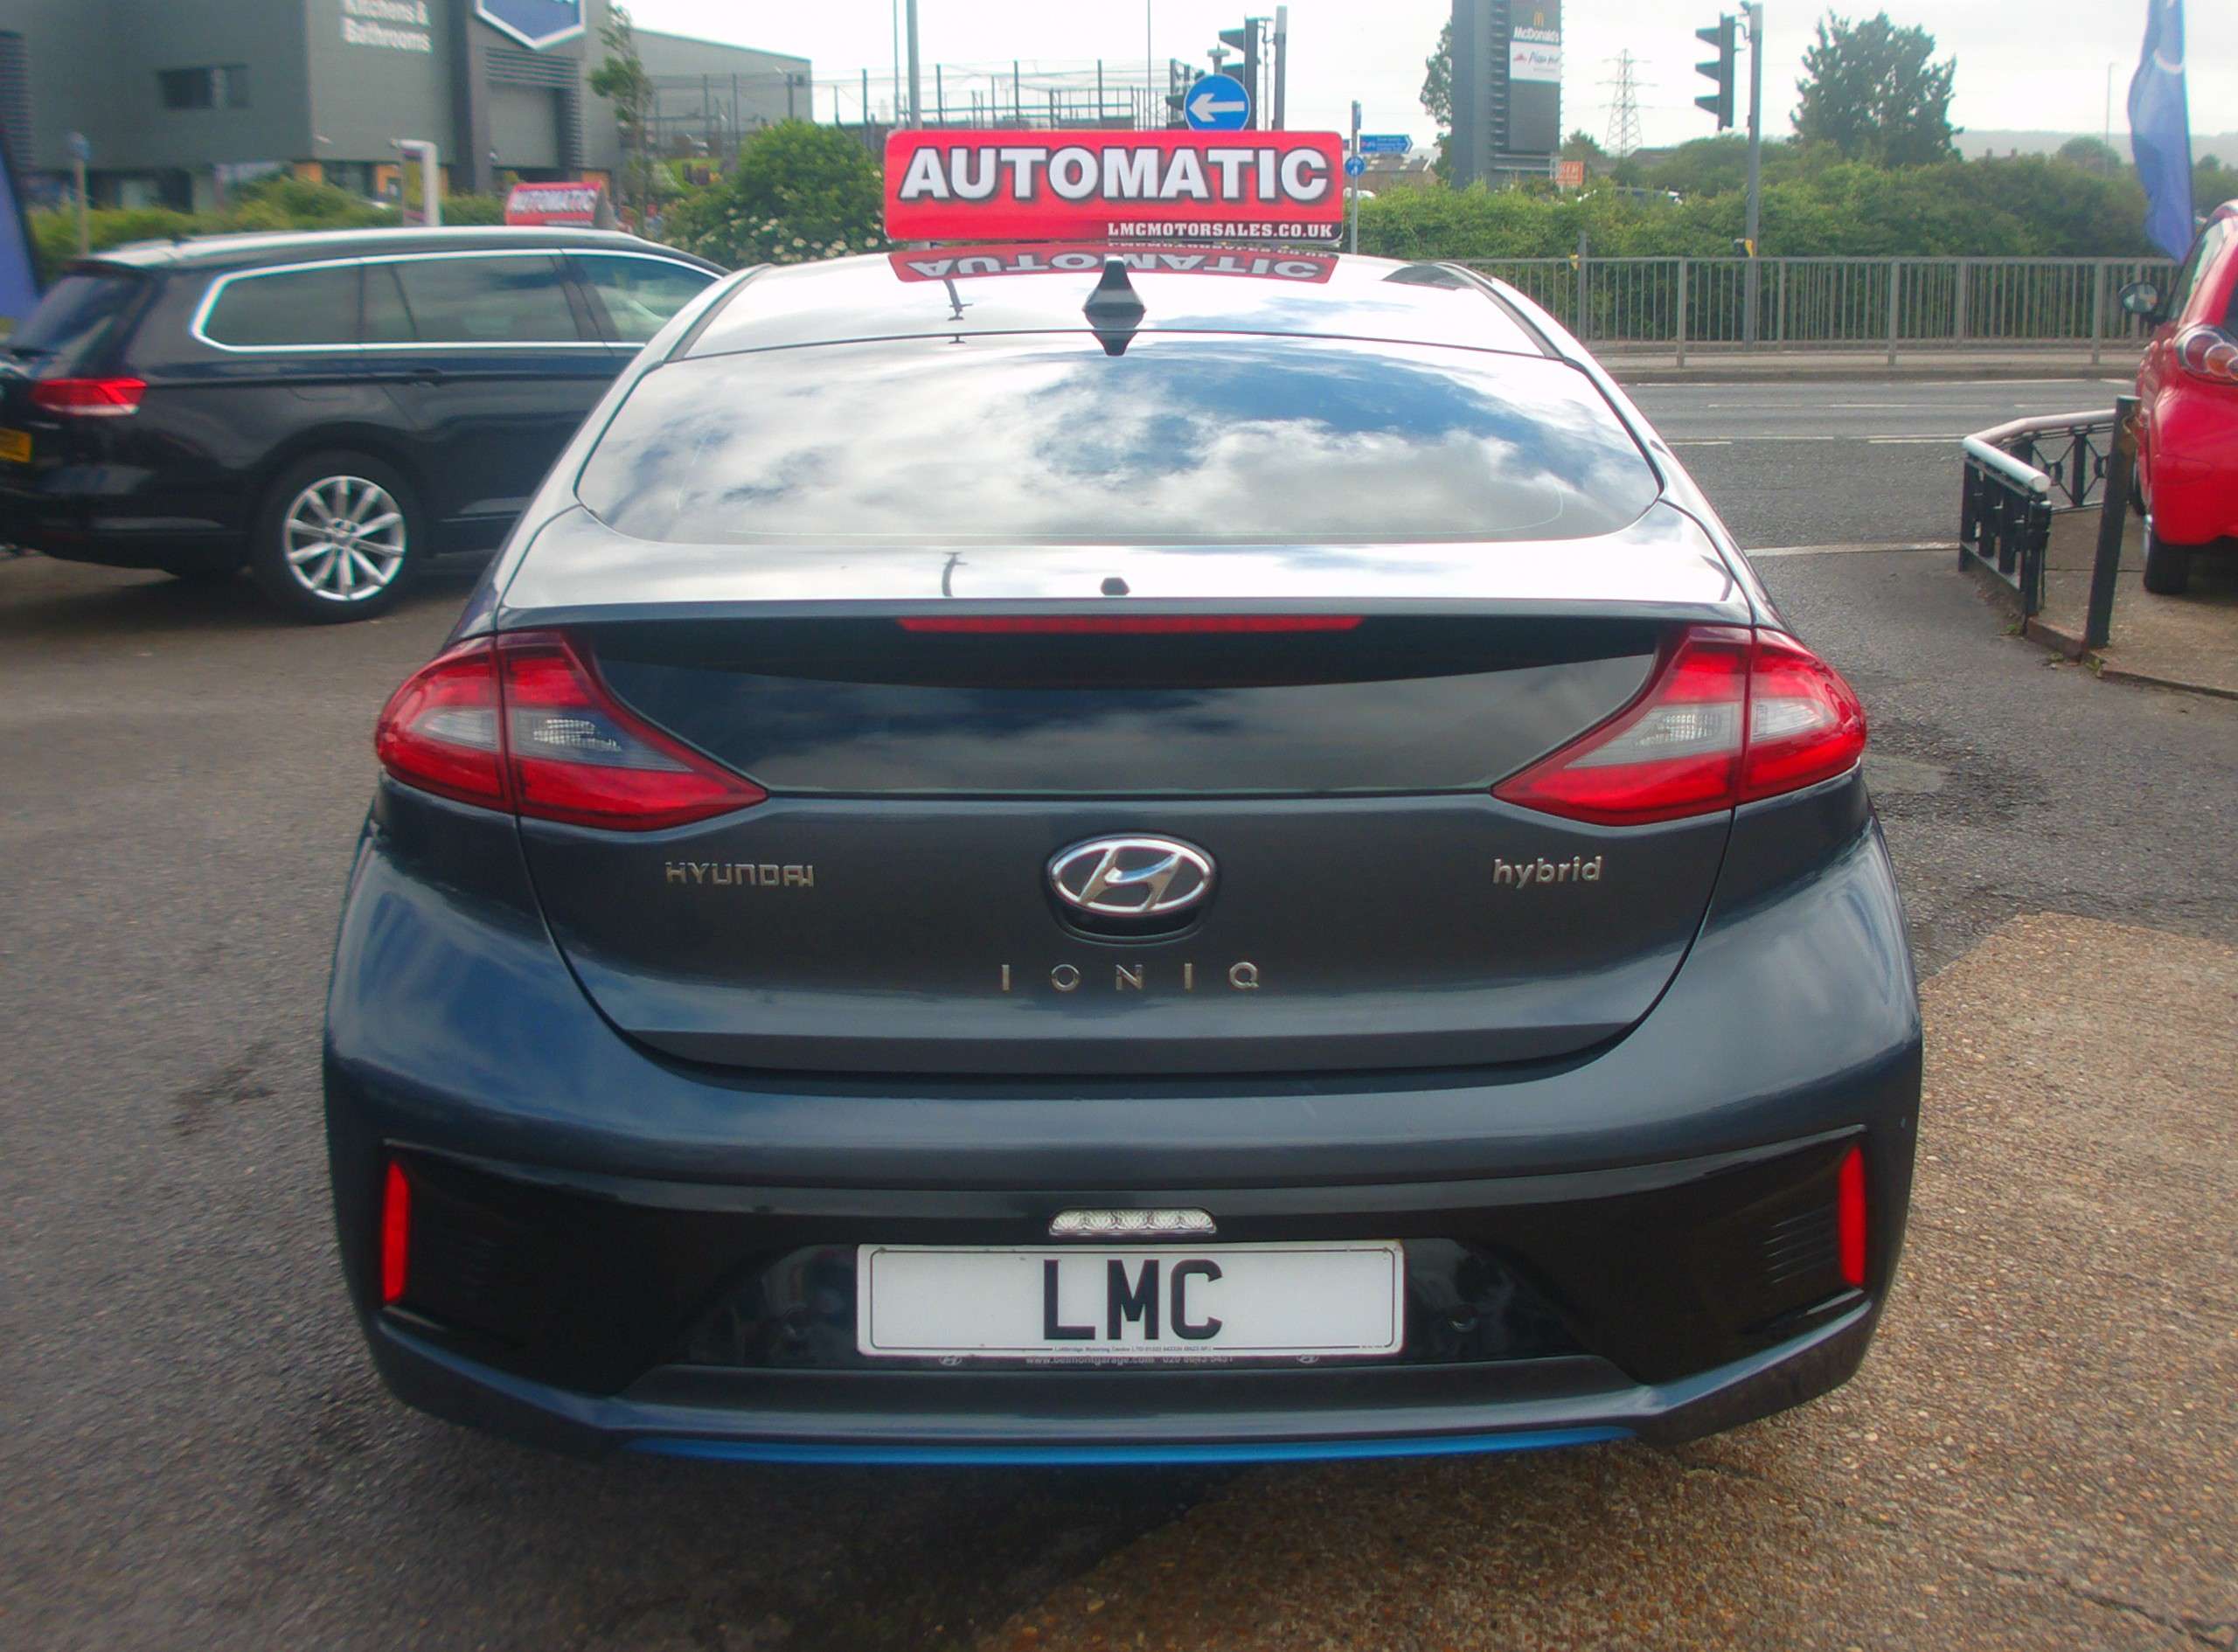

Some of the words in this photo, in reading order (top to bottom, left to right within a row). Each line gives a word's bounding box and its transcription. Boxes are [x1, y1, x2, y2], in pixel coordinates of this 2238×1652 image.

[900, 147, 1328, 201] AUTOMATIC
[1108, 223, 1333, 238] LMCMOTORSALES.CO.UK
[665, 862, 814, 887] HYUNDAI
[1493, 856, 1602, 888] hybrid
[1002, 961, 1259, 991] IONIQ
[1043, 1260, 1223, 1340] LMC
